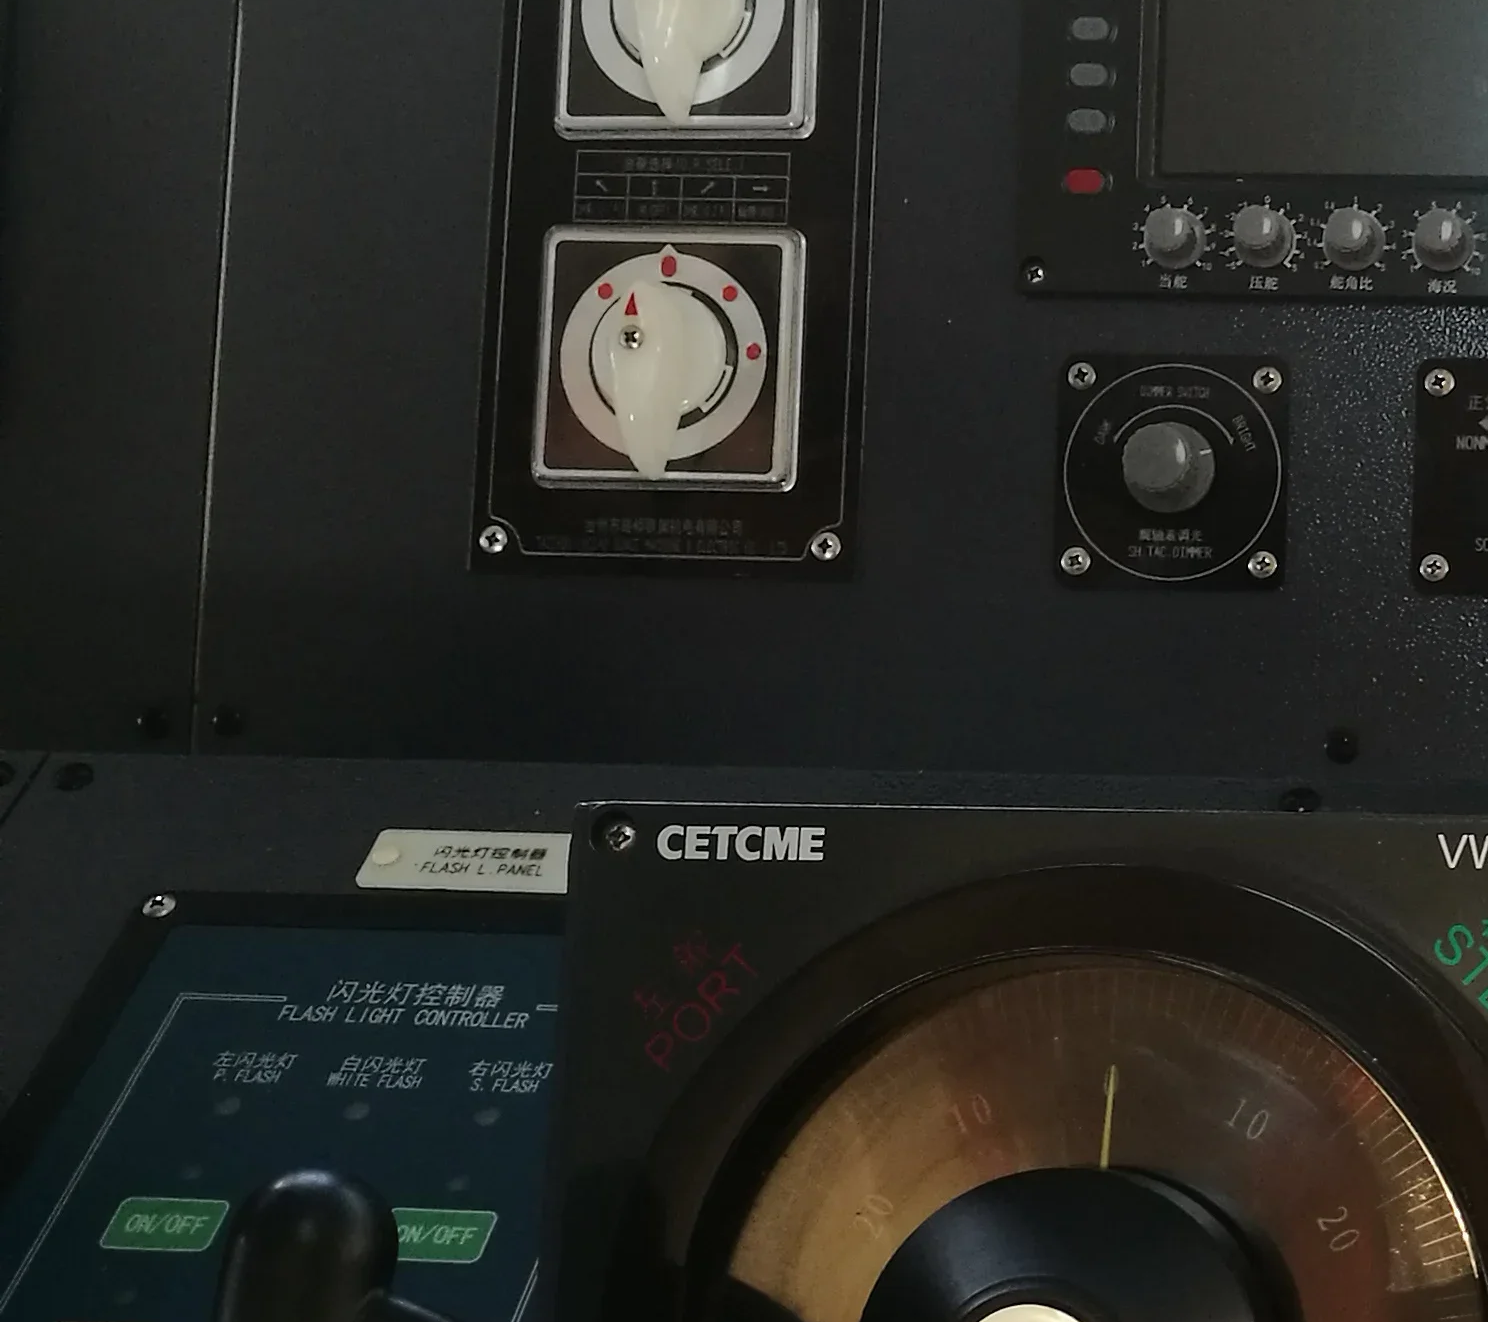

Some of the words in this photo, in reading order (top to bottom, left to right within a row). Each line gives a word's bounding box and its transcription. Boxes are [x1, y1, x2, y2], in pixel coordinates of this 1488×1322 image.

[1329, 275, 1374, 292] 舵角比
[1427, 278, 1458, 294] 海况
[433, 845, 549, 861] 闪光灯控制器
[655, 824, 828, 862] CETCME
[419, 861, 471, 875] FLASH
[497, 863, 543, 877] PANEL
[326, 979, 506, 1010] 闪光灯控制器
[277, 1004, 339, 1023] FLASH
[344, 1006, 406, 1024] LIGHT
[413, 1008, 531, 1029] CONTROLLER
[643, 940, 761, 1075] PORT
[213, 1050, 299, 1071] 左闪光灯
[468, 1059, 554, 1080] 右闪光灯
[234, 1069, 283, 1084] FLASH
[326, 1071, 371, 1088] WHITE
[376, 1073, 424, 1089] FLASH
[491, 1079, 540, 1094] FLASH
[1224, 1097, 1271, 1141] 10
[123, 1214, 210, 1235] ON/OFF
[397, 1223, 478, 1246] ON/OFF
[1316, 1205, 1361, 1253] 20
